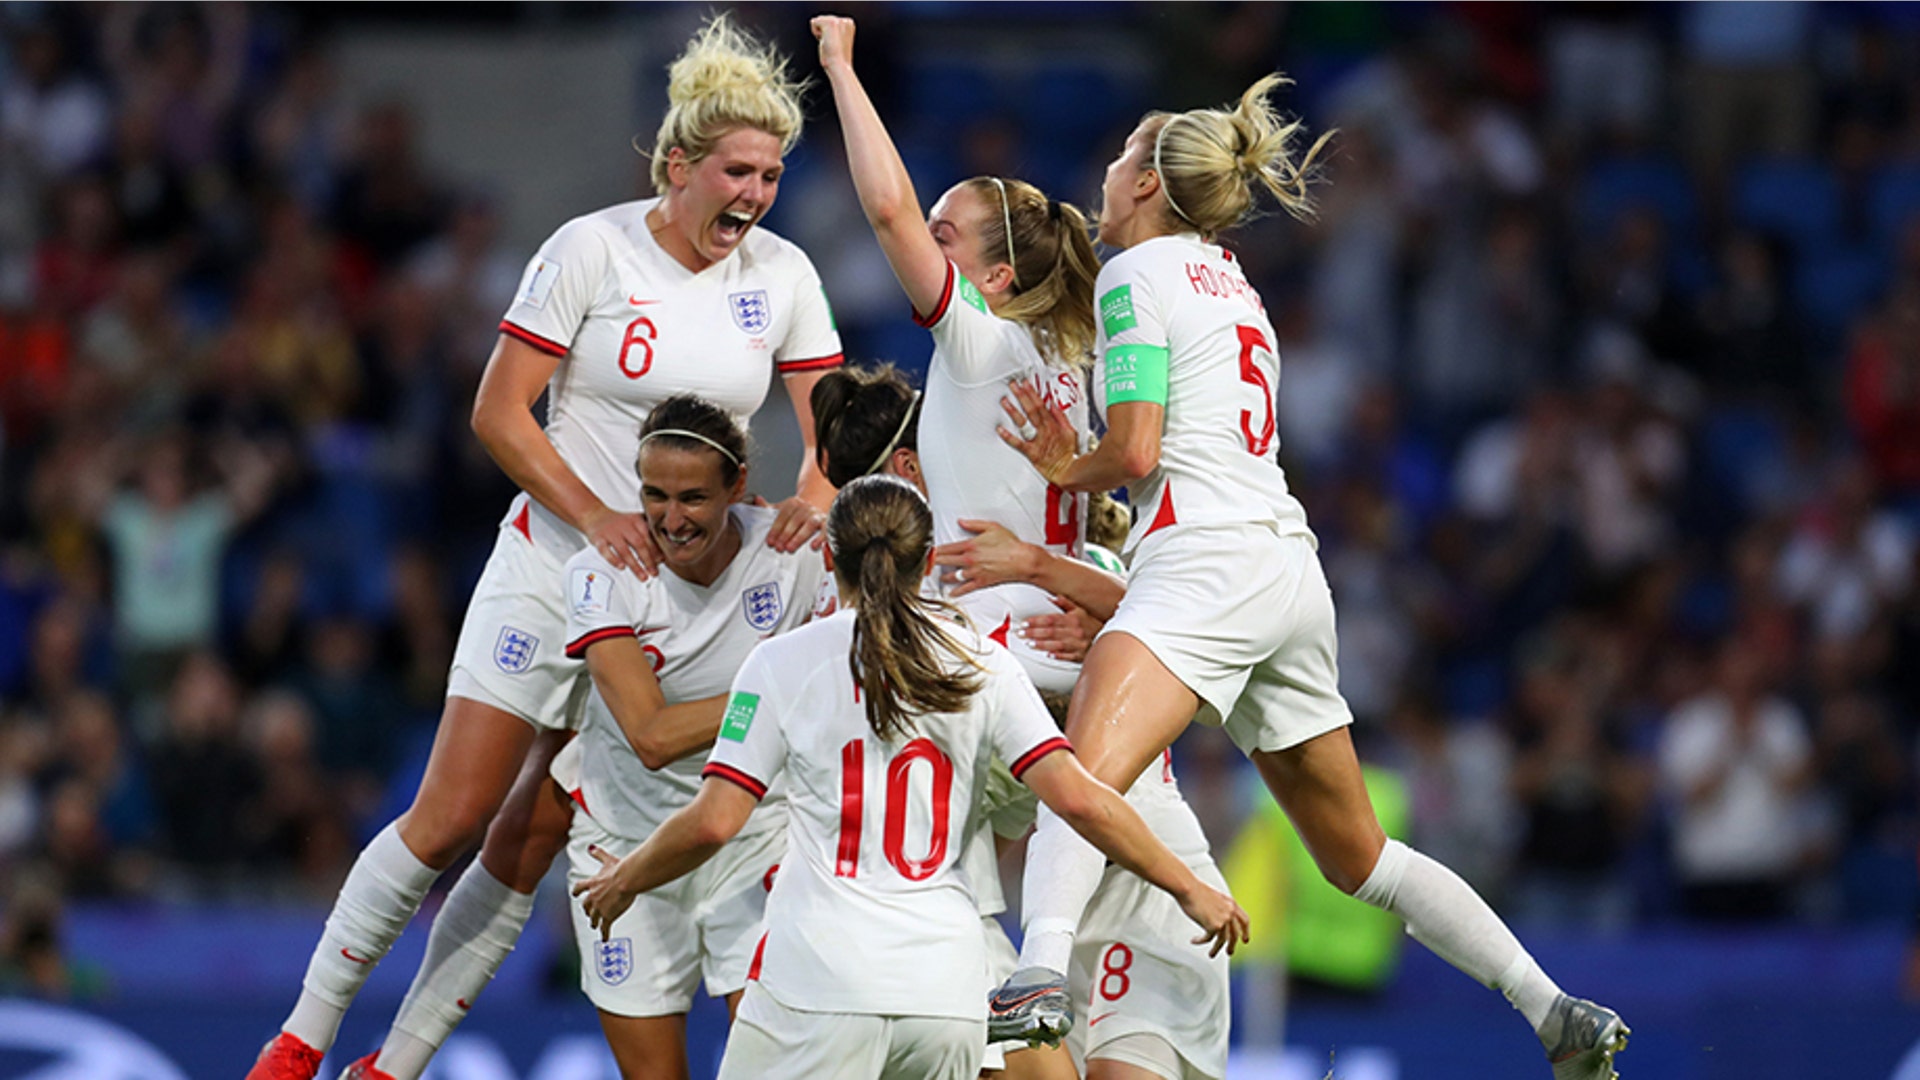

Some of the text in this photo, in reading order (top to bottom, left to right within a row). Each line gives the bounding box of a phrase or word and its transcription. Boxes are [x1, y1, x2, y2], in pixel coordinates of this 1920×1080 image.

[618, 317, 657, 380] 6
[1110, 381, 1137, 393] FIFA
[1235, 324, 1275, 457] 5
[835, 737, 954, 881] 10
[1099, 942, 1133, 1001] 8
